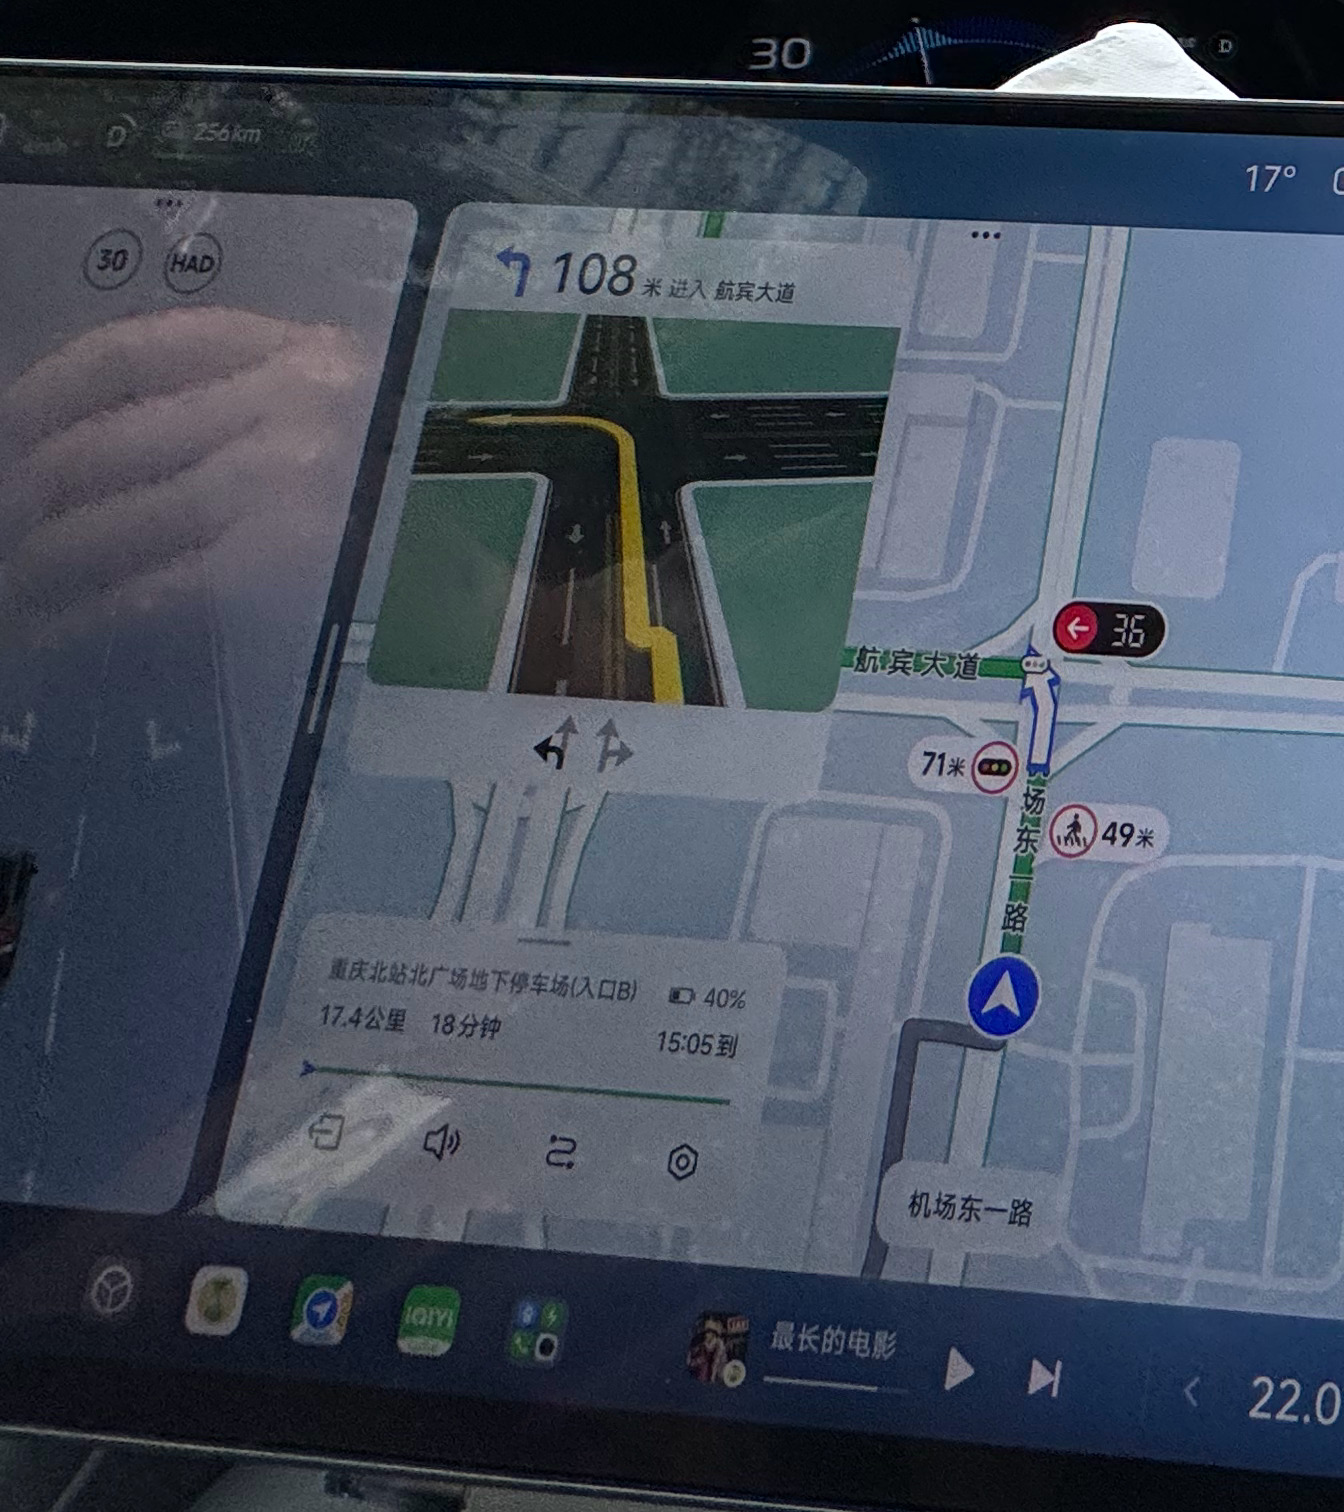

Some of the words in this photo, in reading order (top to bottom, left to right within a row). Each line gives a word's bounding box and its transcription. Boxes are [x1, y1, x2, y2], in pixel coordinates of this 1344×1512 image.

[748, 37, 812, 70] 30
[1245, 164, 1297, 194] 17°
[96, 247, 129, 272] 30
[169, 252, 215, 274] HAD
[668, 277, 708, 300] 进入
[713, 280, 796, 305] 航宾大道
[1110, 612, 1146, 649] 36
[853, 645, 982, 681] 航宾大道
[1001, 766, 1050, 933] 场东一路
[702, 986, 747, 1011] 40%
[320, 1003, 407, 1034] 17.4公里
[431, 1012, 503, 1040] 18分钟
[656, 1031, 740, 1059] 15:05到
[907, 1189, 1034, 1228] 机场东一路
[769, 1319, 898, 1361] 最长的电影
